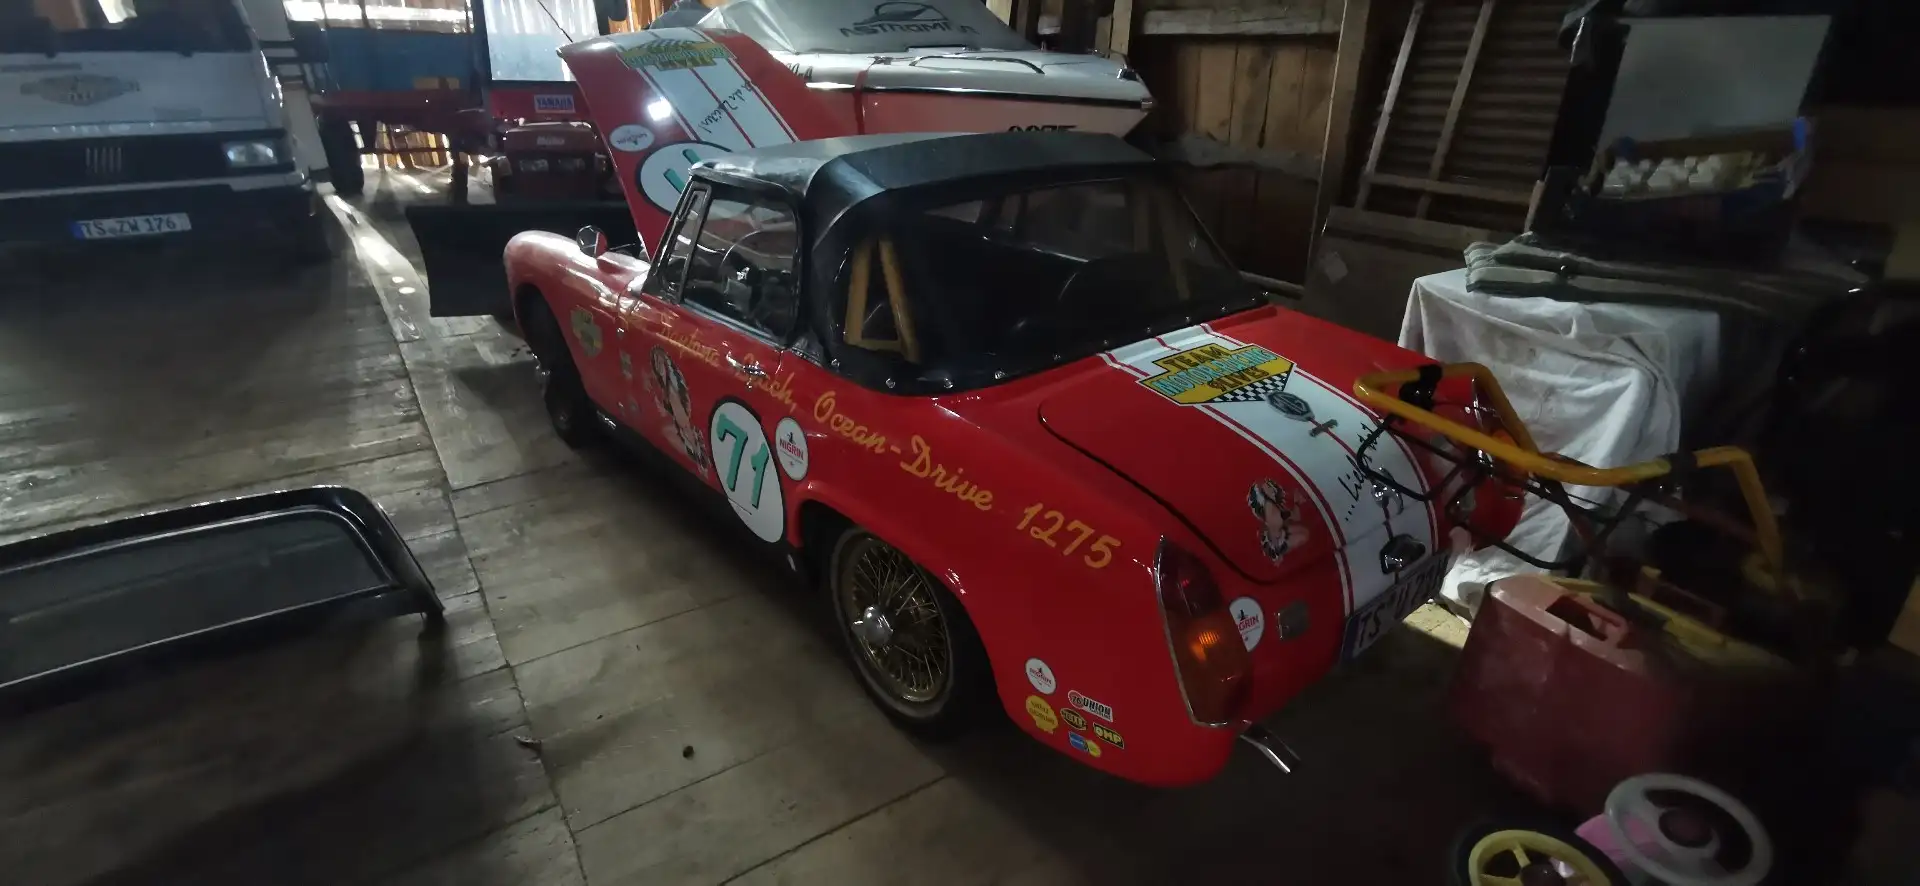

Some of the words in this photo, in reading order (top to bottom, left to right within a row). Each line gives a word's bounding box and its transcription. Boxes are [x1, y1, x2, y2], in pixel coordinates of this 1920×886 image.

[779, 437, 805, 461] NIGRIN
[715, 412, 770, 510] 71
[813, 391, 994, 511] Ocean-Drive
[1015, 502, 1122, 569] 1275
[1237, 613, 1260, 631] GRIN
[1083, 697, 1111, 716] UNION
[1095, 725, 1122, 745] OMP
